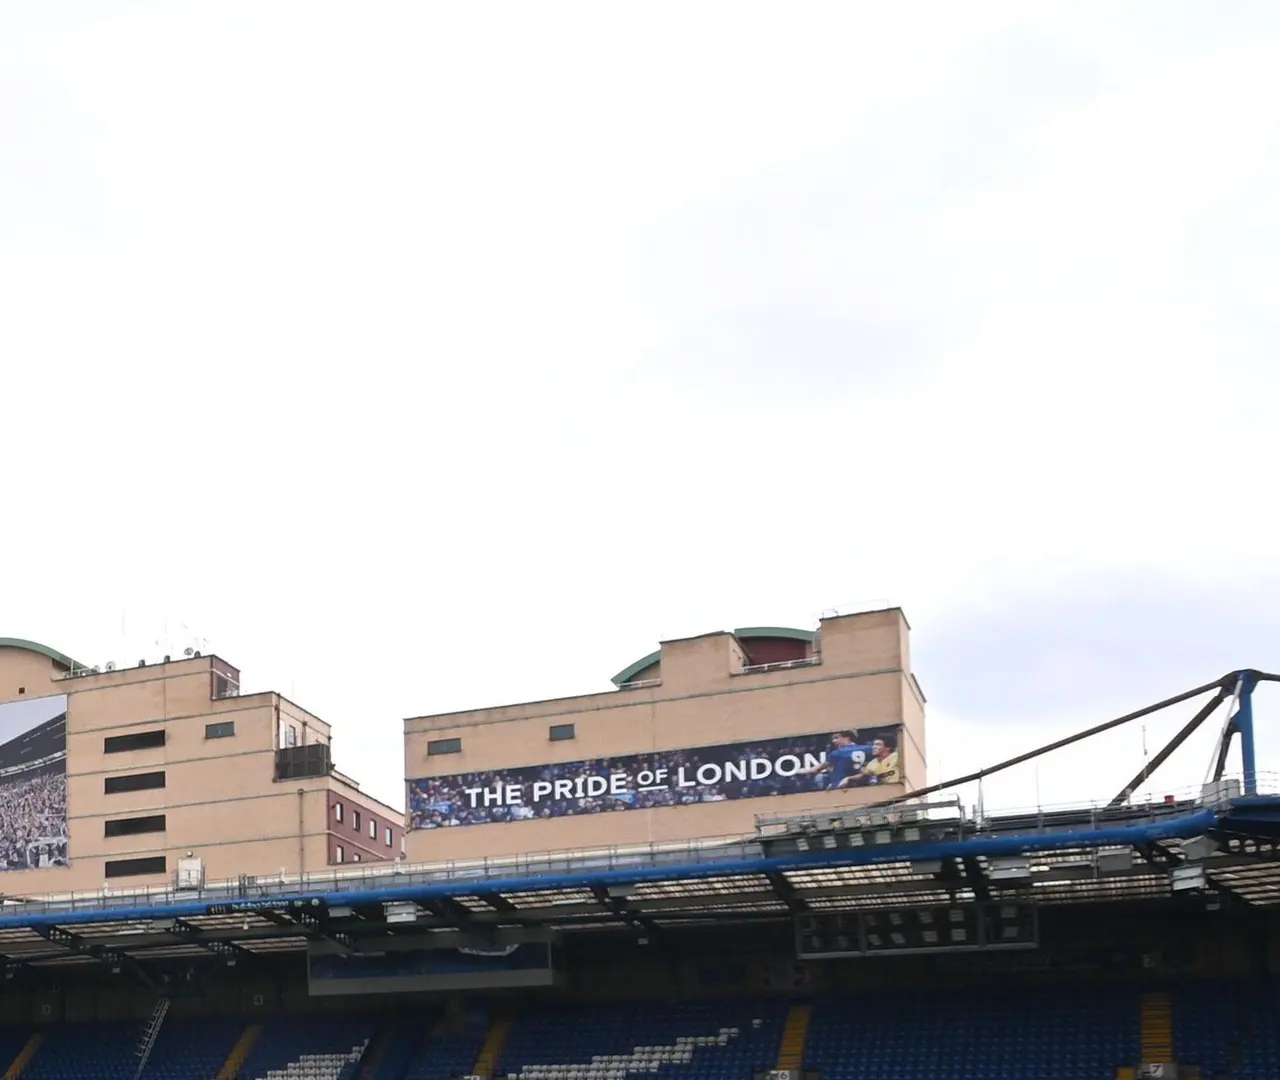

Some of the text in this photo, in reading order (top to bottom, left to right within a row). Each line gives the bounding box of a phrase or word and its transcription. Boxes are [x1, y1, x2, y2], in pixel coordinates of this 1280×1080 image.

[465, 750, 827, 808] THE PRIDE OF LONDON
